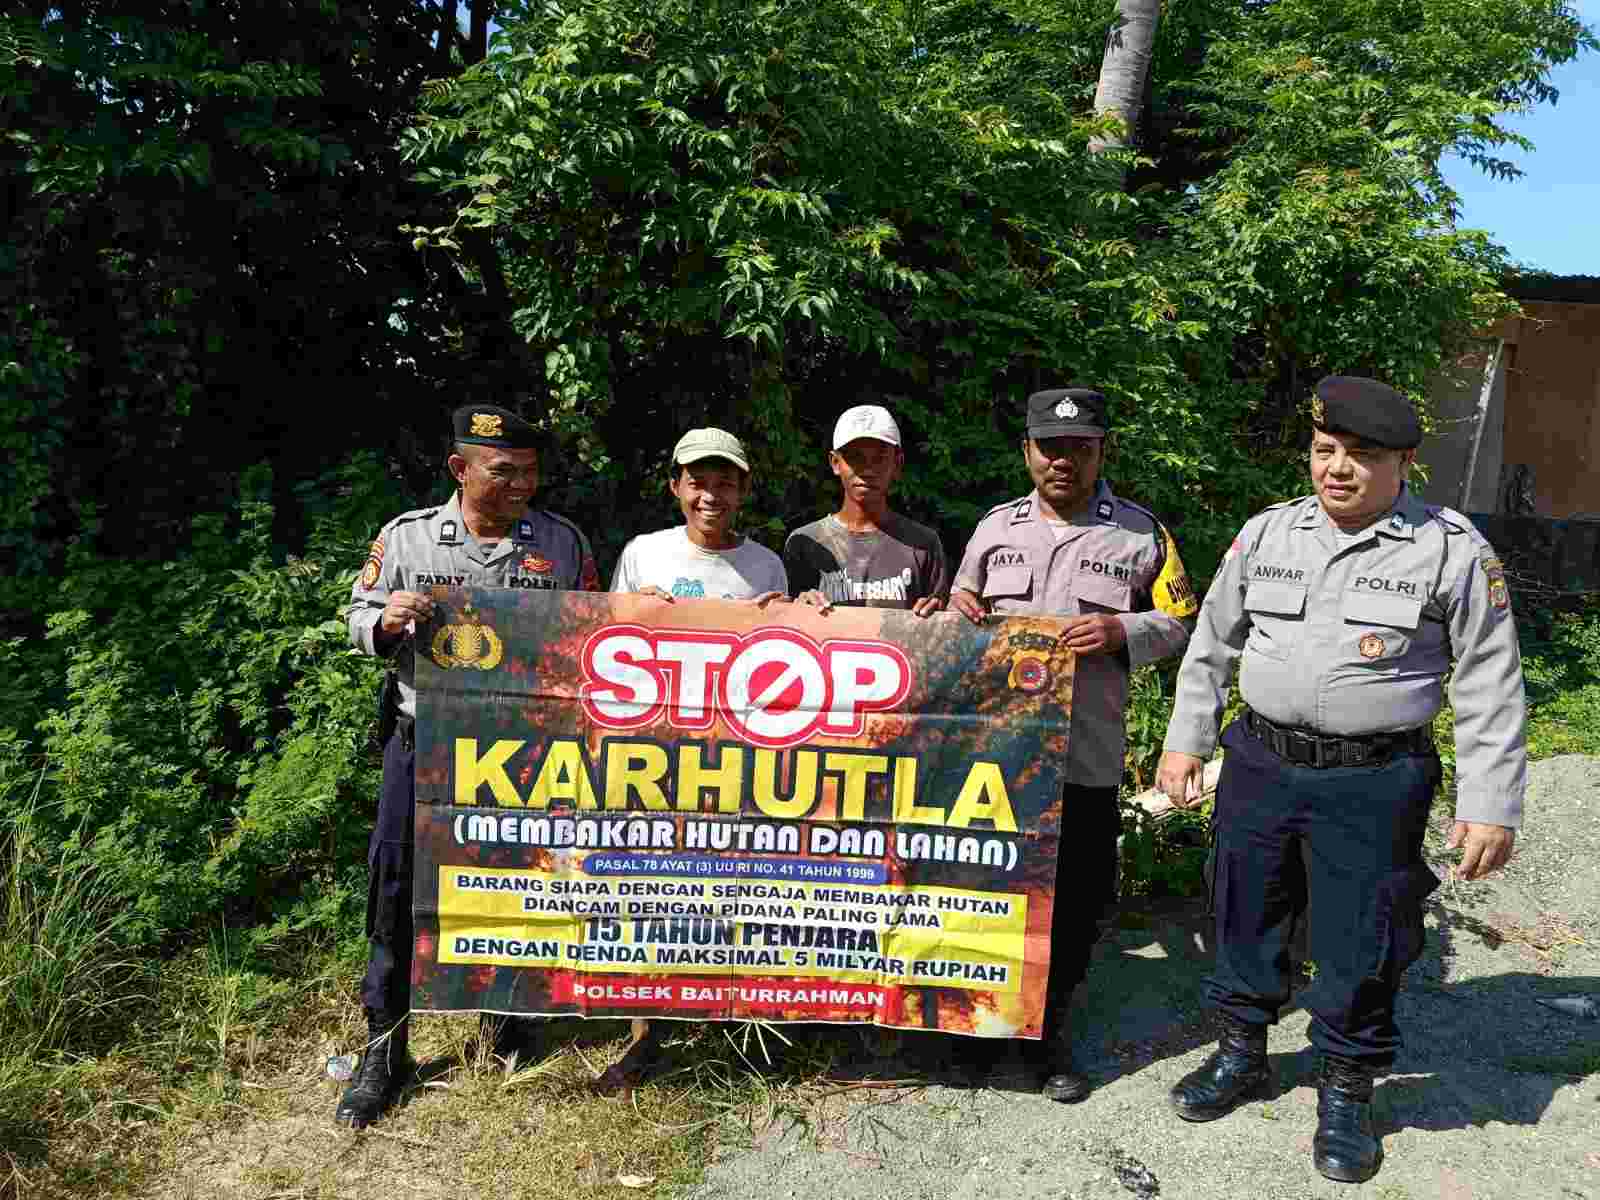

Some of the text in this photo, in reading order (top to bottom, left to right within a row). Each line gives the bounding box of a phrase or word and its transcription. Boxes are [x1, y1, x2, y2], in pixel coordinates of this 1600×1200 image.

[992, 550, 1024, 566] JAYA
[1080, 559, 1129, 580] POLRI
[1253, 565, 1304, 581] ANWAR
[1354, 575, 1416, 596] POLRI
[586, 630, 905, 743] STOP
[454, 737, 1018, 833] KARHUTLA
[453, 813, 1019, 872] (MEMBAKAR HUTAN DAN LAHAN)
[595, 859, 639, 871] PASAL
[641, 859, 658, 871] 78
[660, 860, 692, 872] AYAT
[696, 861, 712, 875] (3)
[715, 862, 734, 874] UU
[737, 863, 751, 873] RI
[753, 863, 777, 875] NO.
[779, 864, 795, 876] 41
[799, 864, 842, 877] TAHUN
[456, 874, 1010, 916] BARANG SIAPA DENGAN SENGAJA MEMBAKAR HUTAN
[523, 897, 941, 928] DIANCAM DENGAN PIDANA PALING LAMA
[587, 916, 880, 952] 15 TAHUN PENJARA
[454, 937, 1008, 983] DENGAN DENDA MAKSIMAL 5 MILYAR RUPIAH
[573, 982, 885, 1007] POLSEK BAITURRAHMAN
